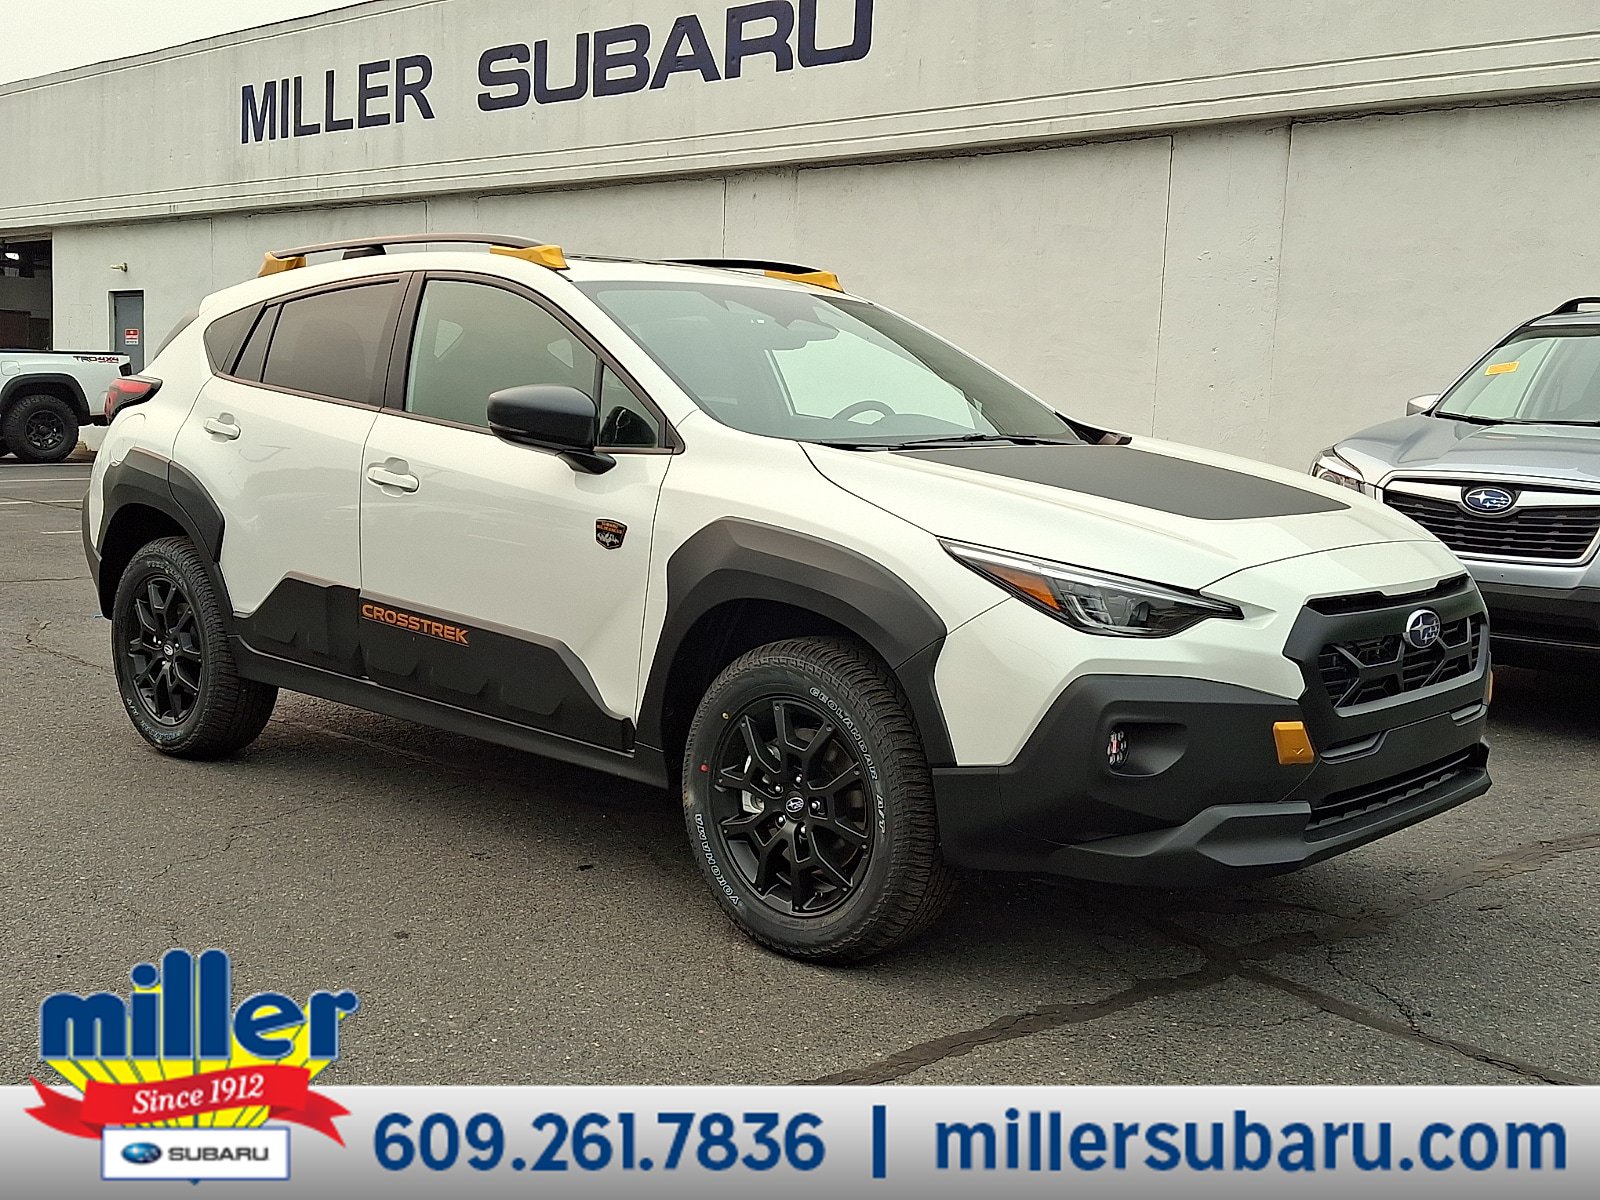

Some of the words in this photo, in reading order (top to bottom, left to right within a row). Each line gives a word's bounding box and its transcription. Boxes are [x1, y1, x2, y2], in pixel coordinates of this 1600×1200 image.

[241, 54, 436, 145] MILLER
[477, 0, 874, 112] SUBARU
[361, 603, 470, 645] CROSSTREK
[809, 686, 878, 781] GEOLANDAR
[694, 813, 740, 905] YOKOHAMA
